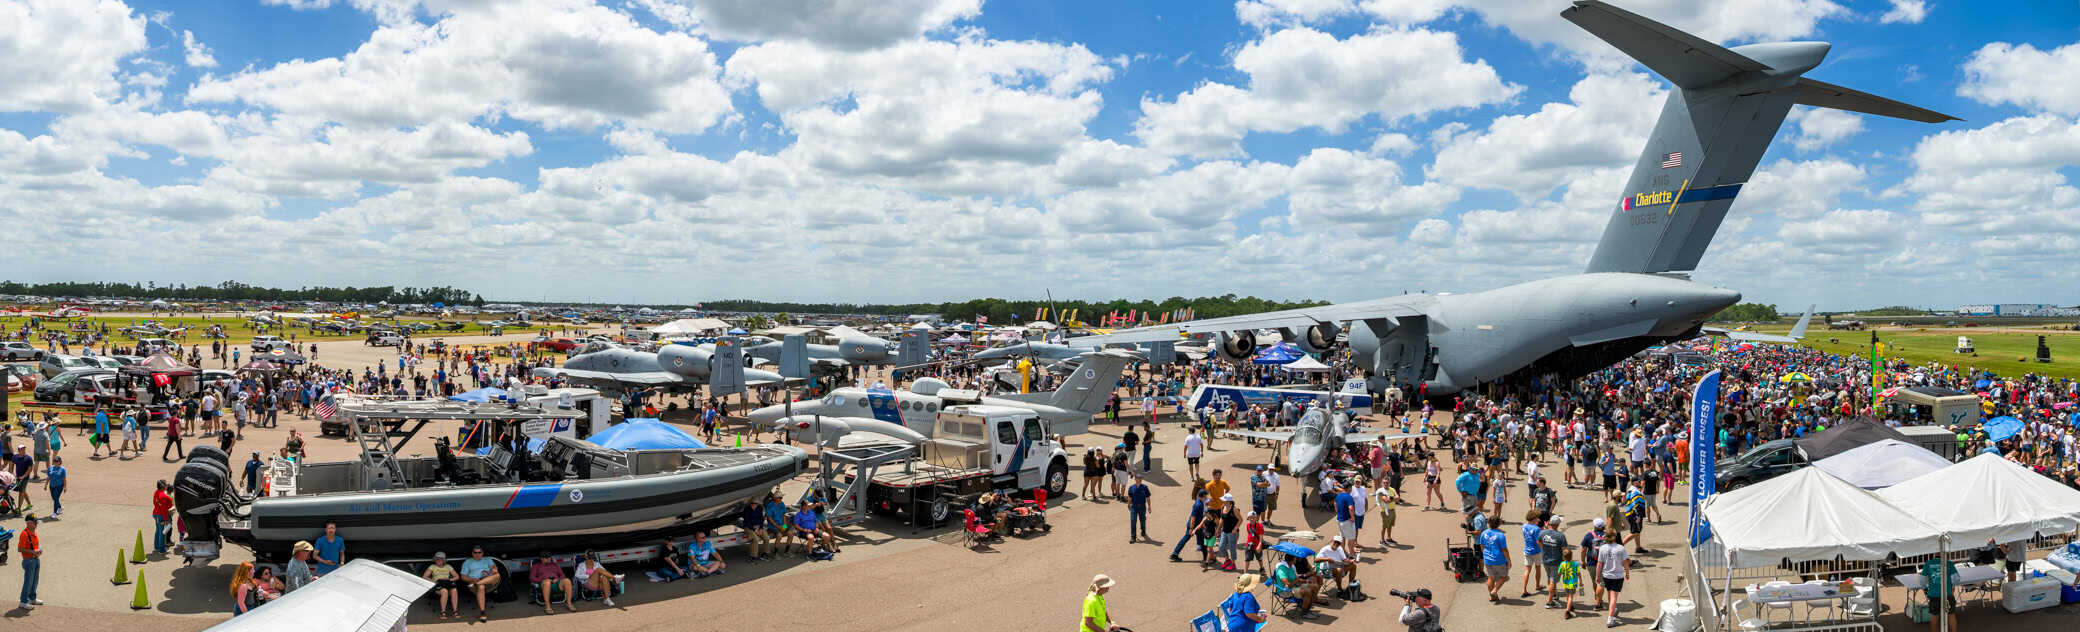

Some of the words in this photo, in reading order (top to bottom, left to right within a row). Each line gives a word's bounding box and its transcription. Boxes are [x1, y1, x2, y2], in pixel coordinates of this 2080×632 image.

[1635, 191, 1672, 207] Charlotte
[1349, 382, 1364, 390] 94F
[1698, 450, 1707, 496] LOANER
[366, 503, 380, 512] and
[382, 503, 412, 512] Marine
[415, 502, 461, 512] Operations
